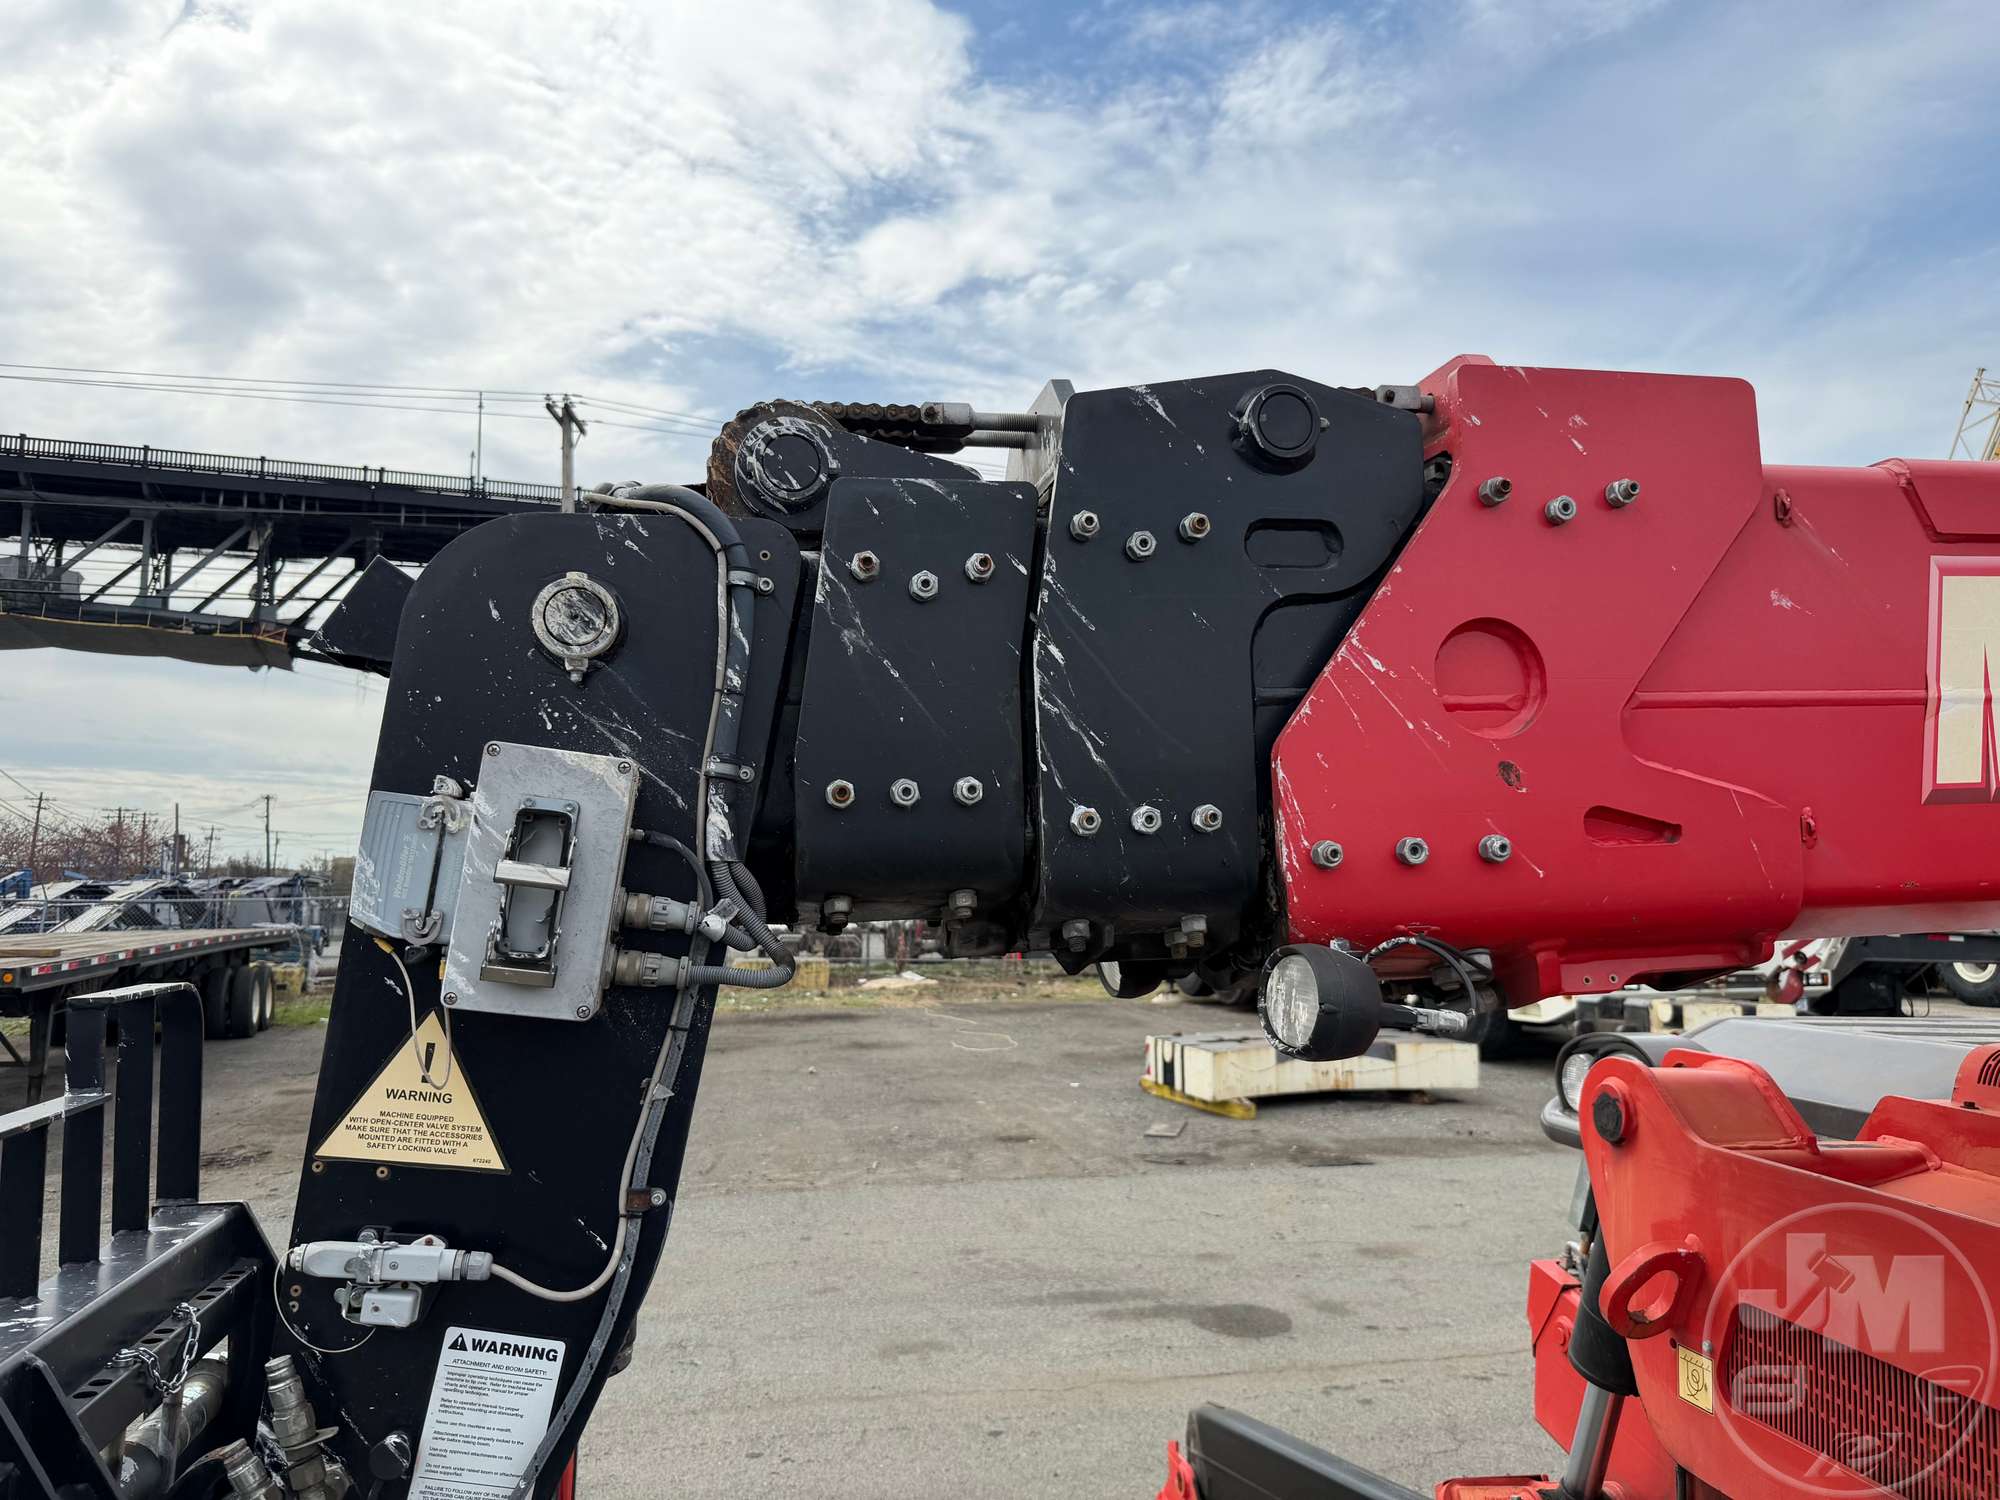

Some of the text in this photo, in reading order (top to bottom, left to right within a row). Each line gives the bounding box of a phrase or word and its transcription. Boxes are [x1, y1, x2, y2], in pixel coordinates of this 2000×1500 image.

[386, 1088, 452, 1103] WARNING
[380, 1111, 454, 1122] MACHINE EQUIPPED
[371, 1118, 424, 1128] OPEN-CENTER
[426, 1122, 449, 1130] VALVE
[451, 1124, 481, 1132] SYSTEM
[358, 1134, 395, 1142] MOUNTED
[430, 1131, 483, 1140] ACCESSORIES
[367, 1142, 457, 1155] SAFETY LOCKING VALVE
[472, 1338, 558, 1362] WARNING
[452, 1359, 491, 1368] ATTACHMENT
[419, 1490, 453, 1499] INSTRUCTIONS
